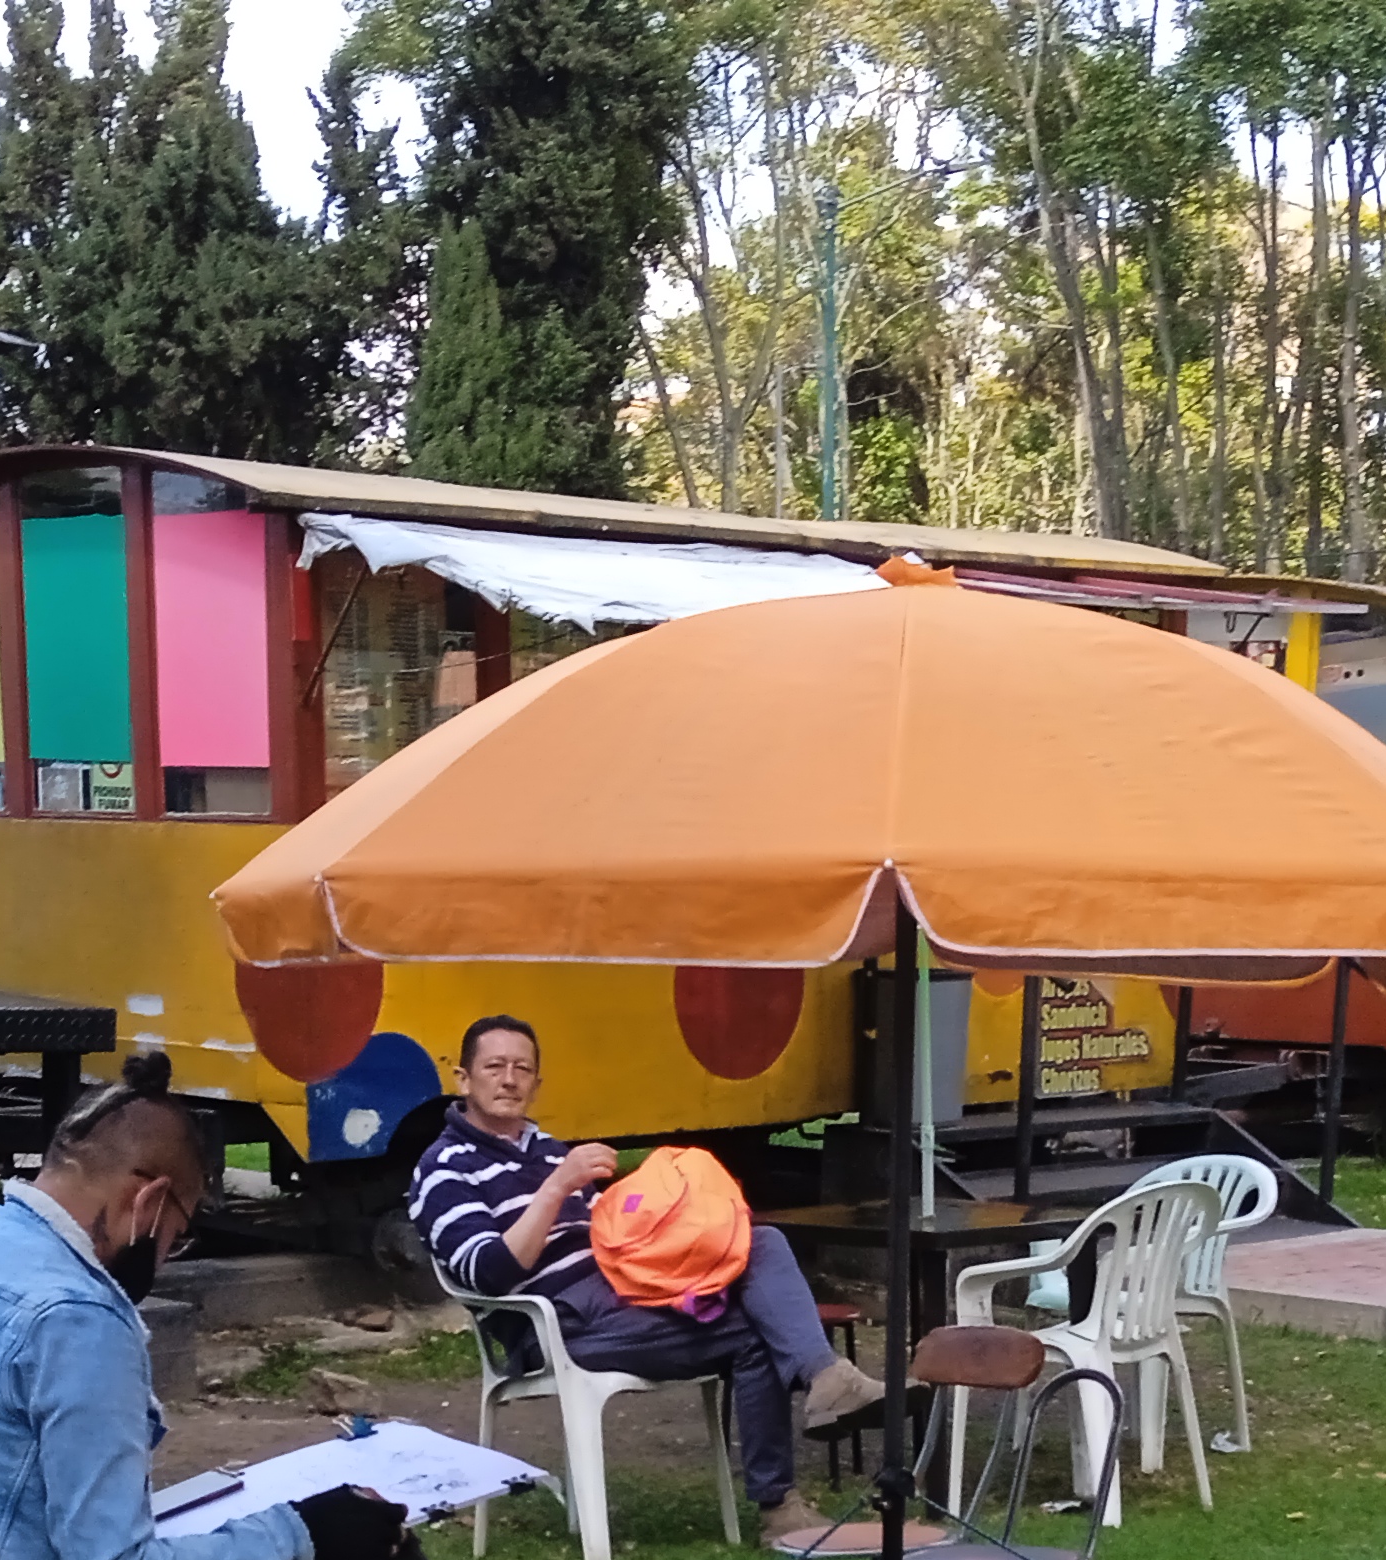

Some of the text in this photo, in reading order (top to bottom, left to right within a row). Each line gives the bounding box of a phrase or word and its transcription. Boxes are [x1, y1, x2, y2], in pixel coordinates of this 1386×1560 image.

[1041, 1001, 1107, 1031] Sandwich
[1040, 1030, 1149, 1065] Jugos Naturales
